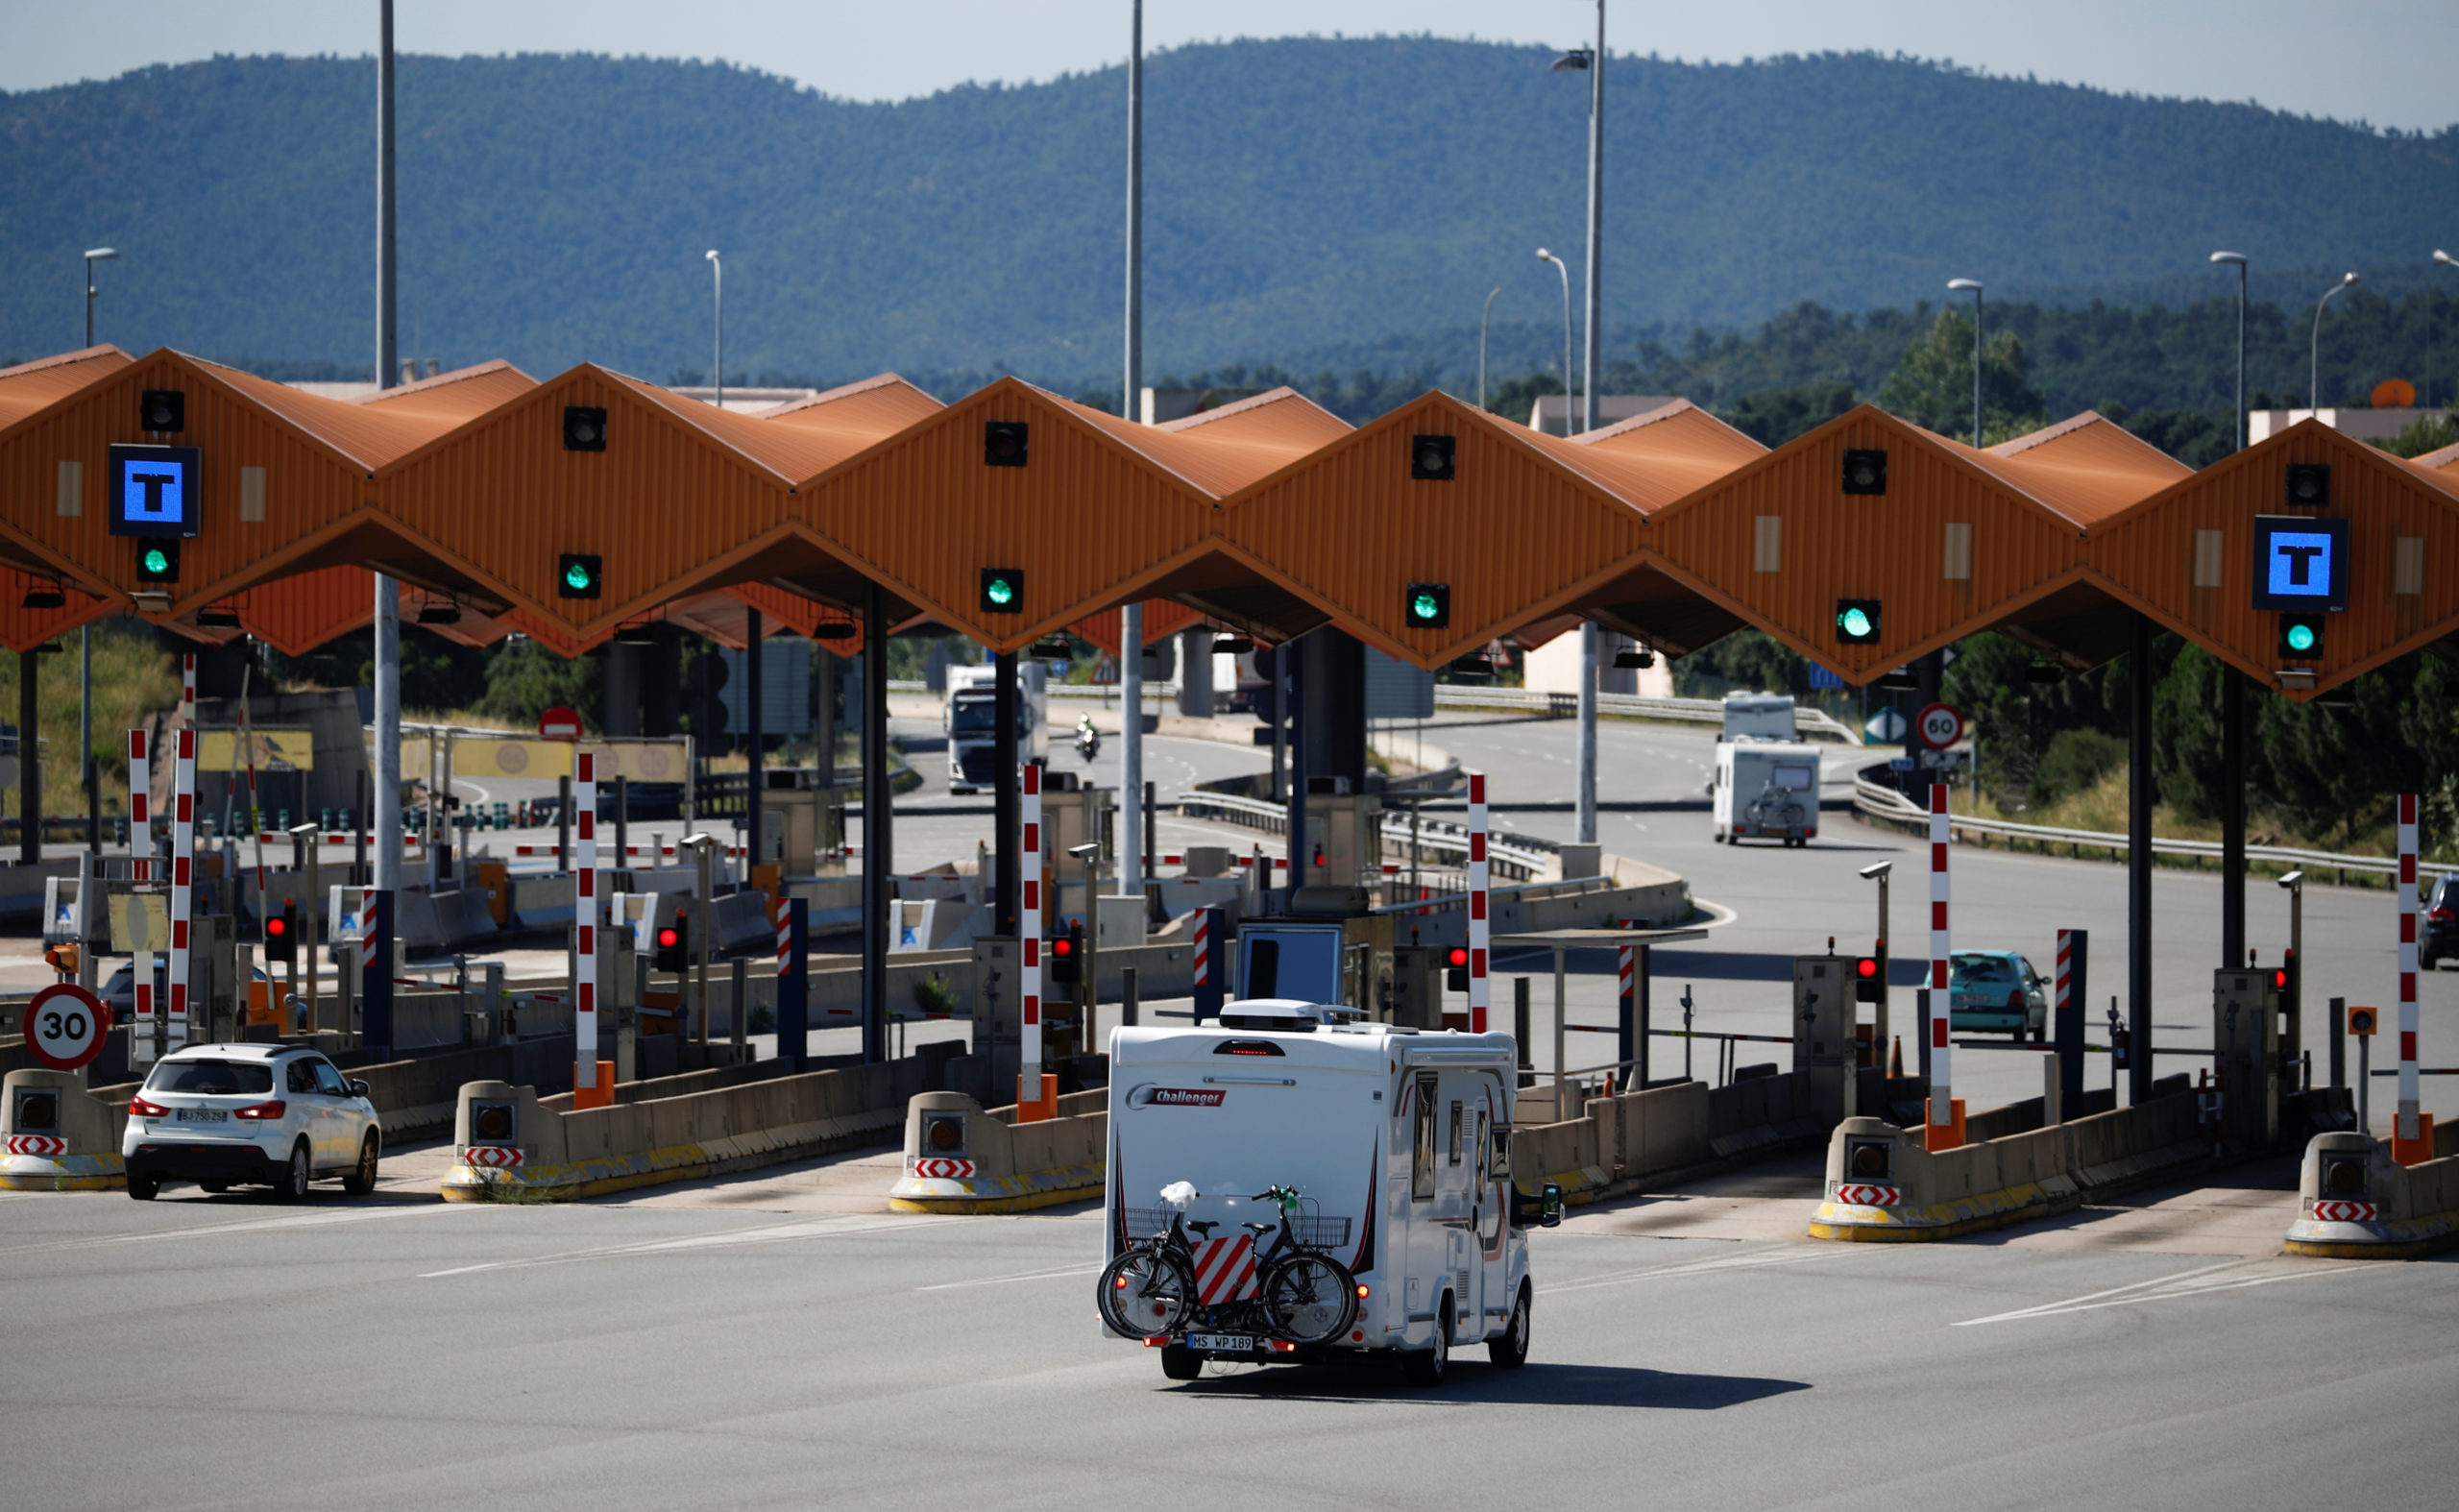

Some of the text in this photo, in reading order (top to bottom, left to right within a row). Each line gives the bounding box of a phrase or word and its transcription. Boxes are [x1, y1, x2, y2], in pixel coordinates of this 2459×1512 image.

[133, 473, 175, 512] T
[2277, 546, 2323, 585] T
[1928, 719, 1954, 734] 60
[43, 1012, 86, 1040] 30
[1156, 1090, 1220, 1106] Challenger
[1193, 1336, 1252, 1349] MS WP 189
